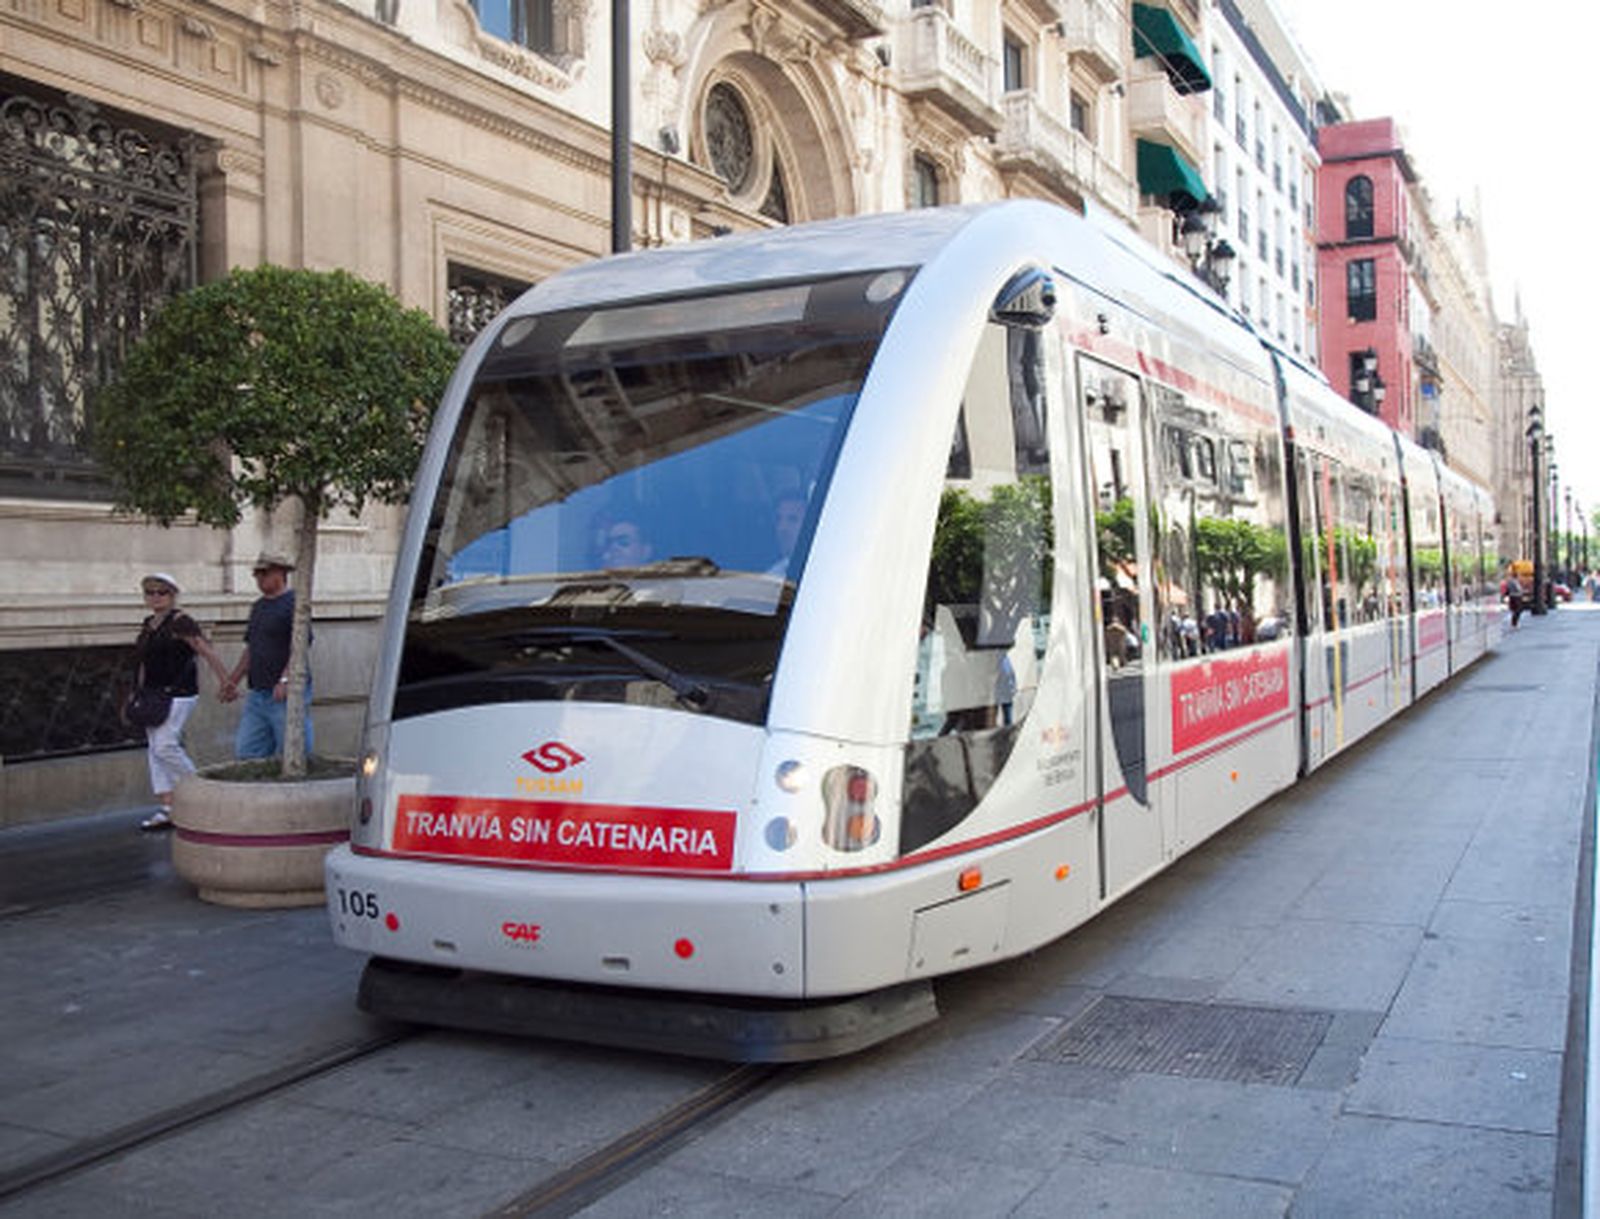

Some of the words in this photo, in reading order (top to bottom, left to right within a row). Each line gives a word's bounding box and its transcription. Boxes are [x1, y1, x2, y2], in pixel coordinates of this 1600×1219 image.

[509, 816, 550, 845] SIN
[556, 819, 719, 857] CATENARIA
[337, 887, 380, 919] 105
